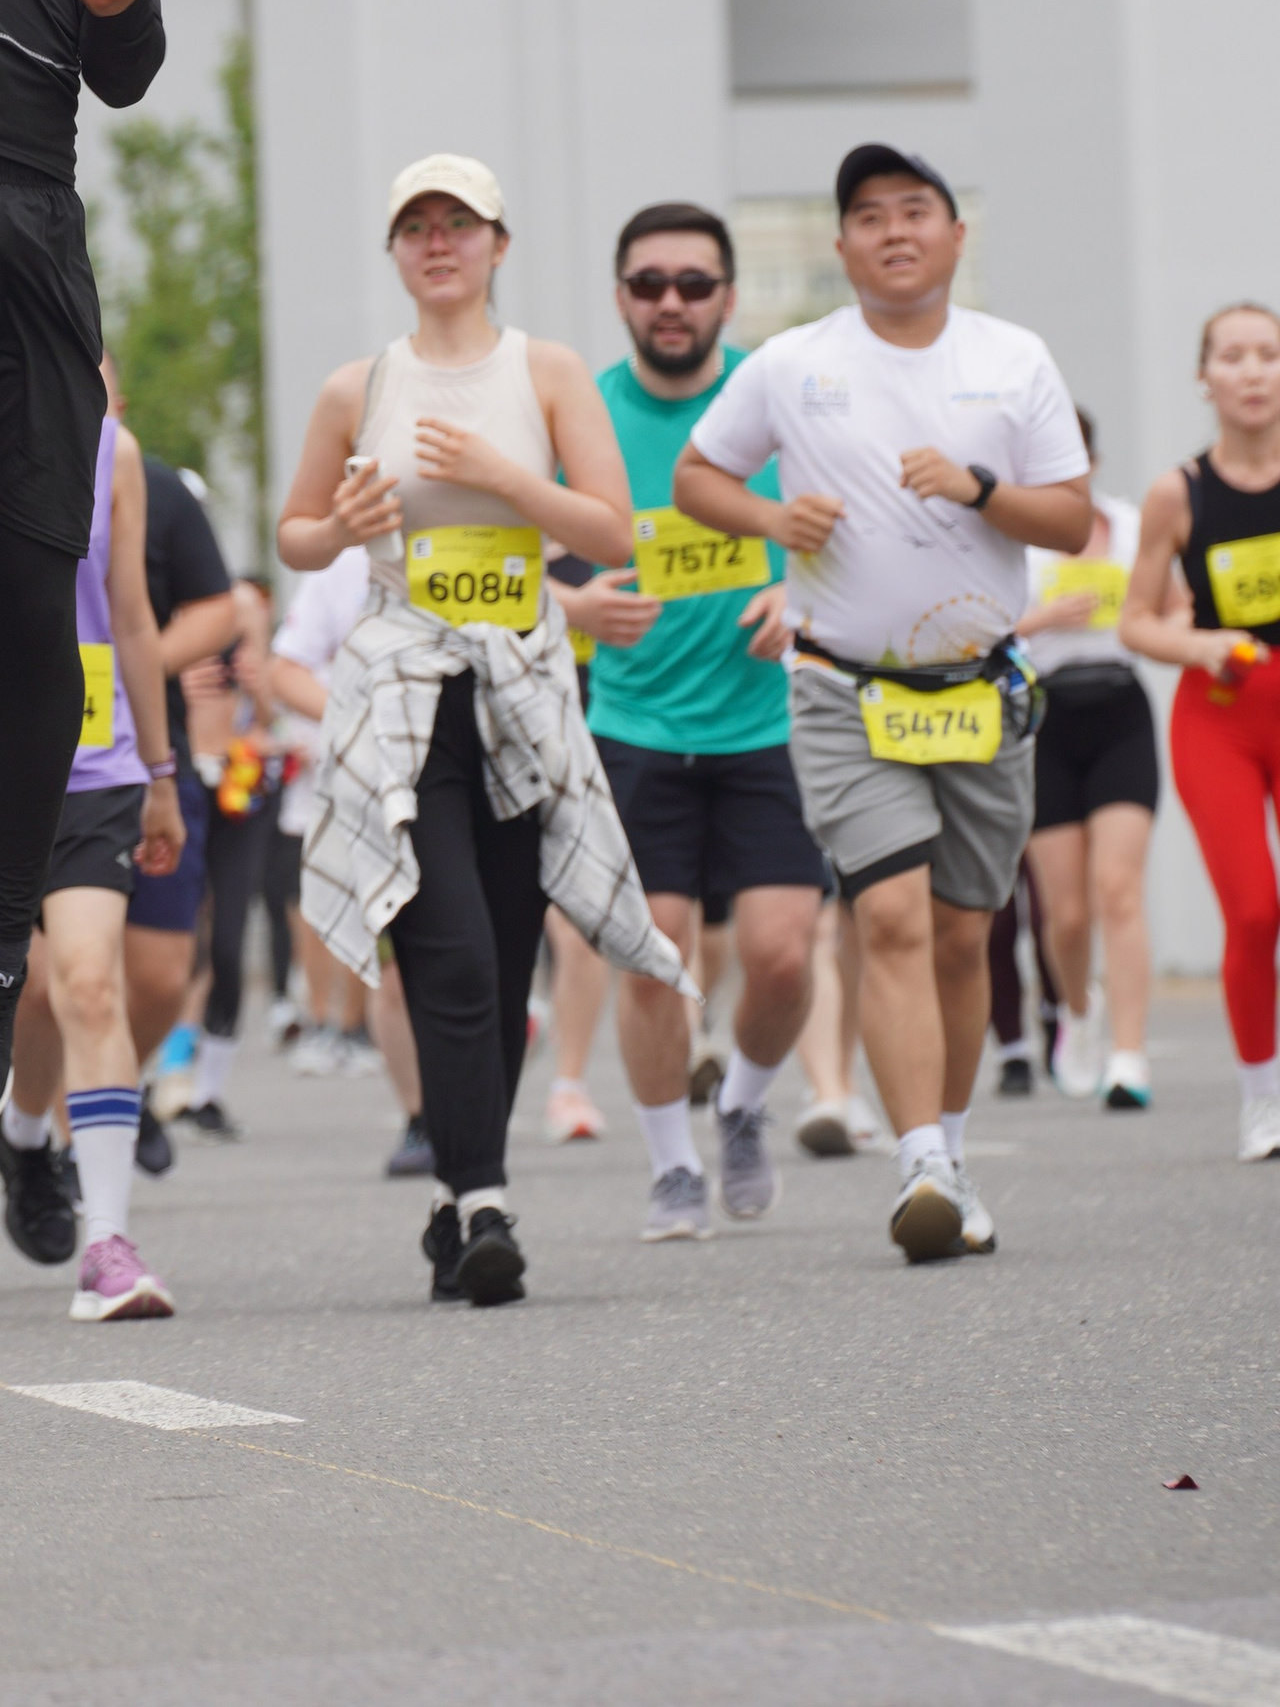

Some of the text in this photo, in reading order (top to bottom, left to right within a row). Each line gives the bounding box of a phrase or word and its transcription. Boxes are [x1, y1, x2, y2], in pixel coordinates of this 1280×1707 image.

[656, 536, 745, 576] 7572
[427, 571, 525, 605] 6084
[885, 710, 980, 740] 5474
